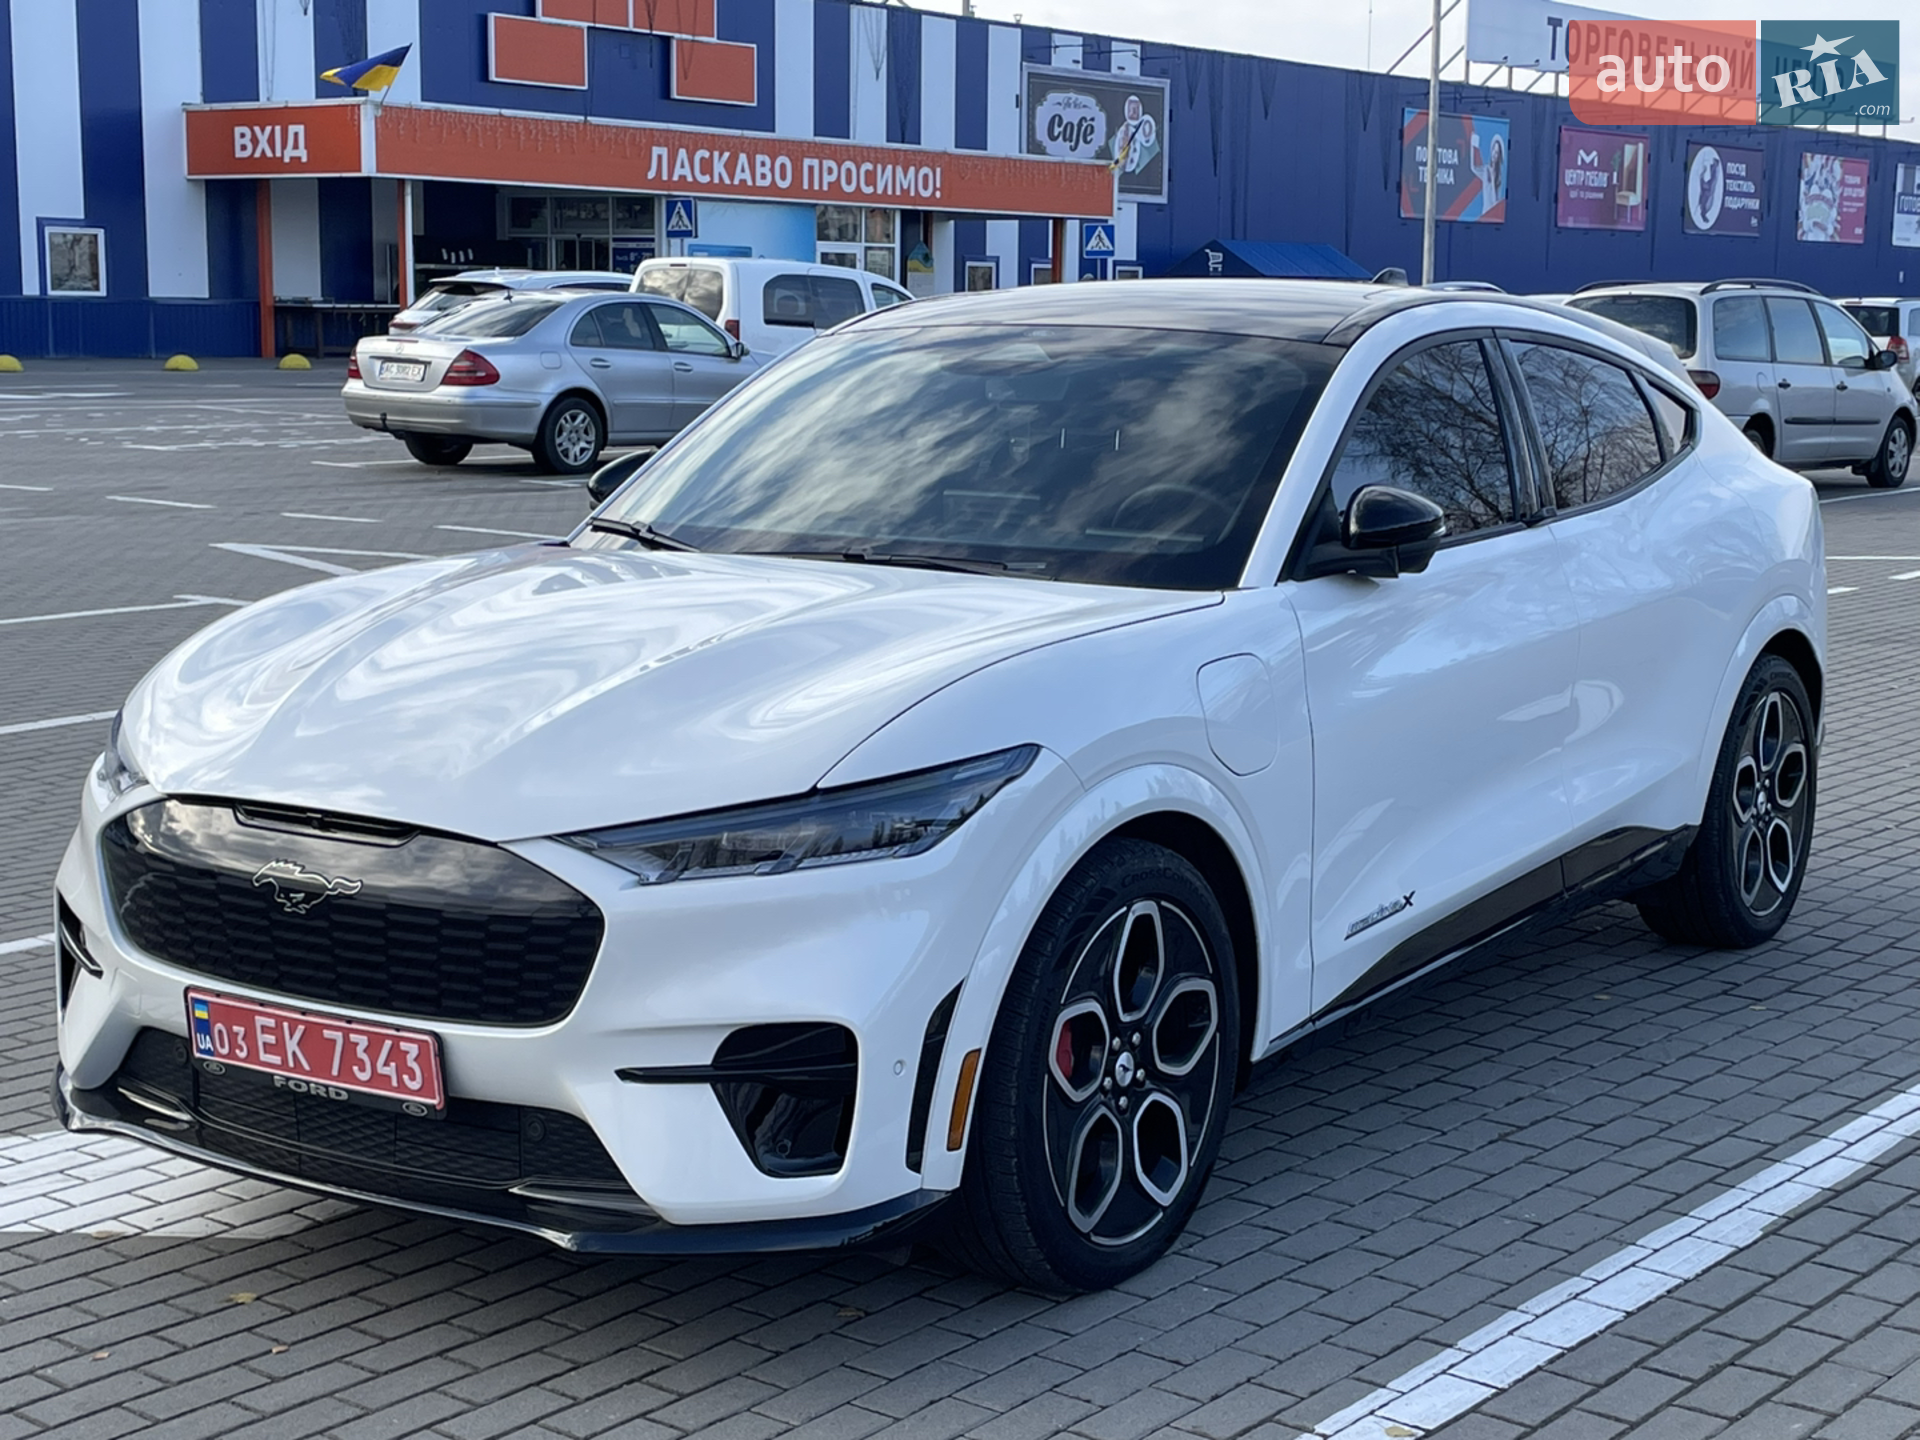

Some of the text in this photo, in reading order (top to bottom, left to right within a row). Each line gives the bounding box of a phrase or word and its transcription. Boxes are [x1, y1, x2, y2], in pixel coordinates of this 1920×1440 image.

[233, 124, 308, 163] ВХІД
[1047, 113, 1096, 152] Café
[1415, 145, 1459, 165] ПОТОВА
[647, 145, 942, 199] ЛАСКАВО ПРОСИМО!
[1418, 166, 1455, 185] ТЕНІКА
[197, 1032, 214, 1052] UA
[213, 1015, 423, 1092] 03 EK 7343
[273, 1075, 349, 1101] FORD
